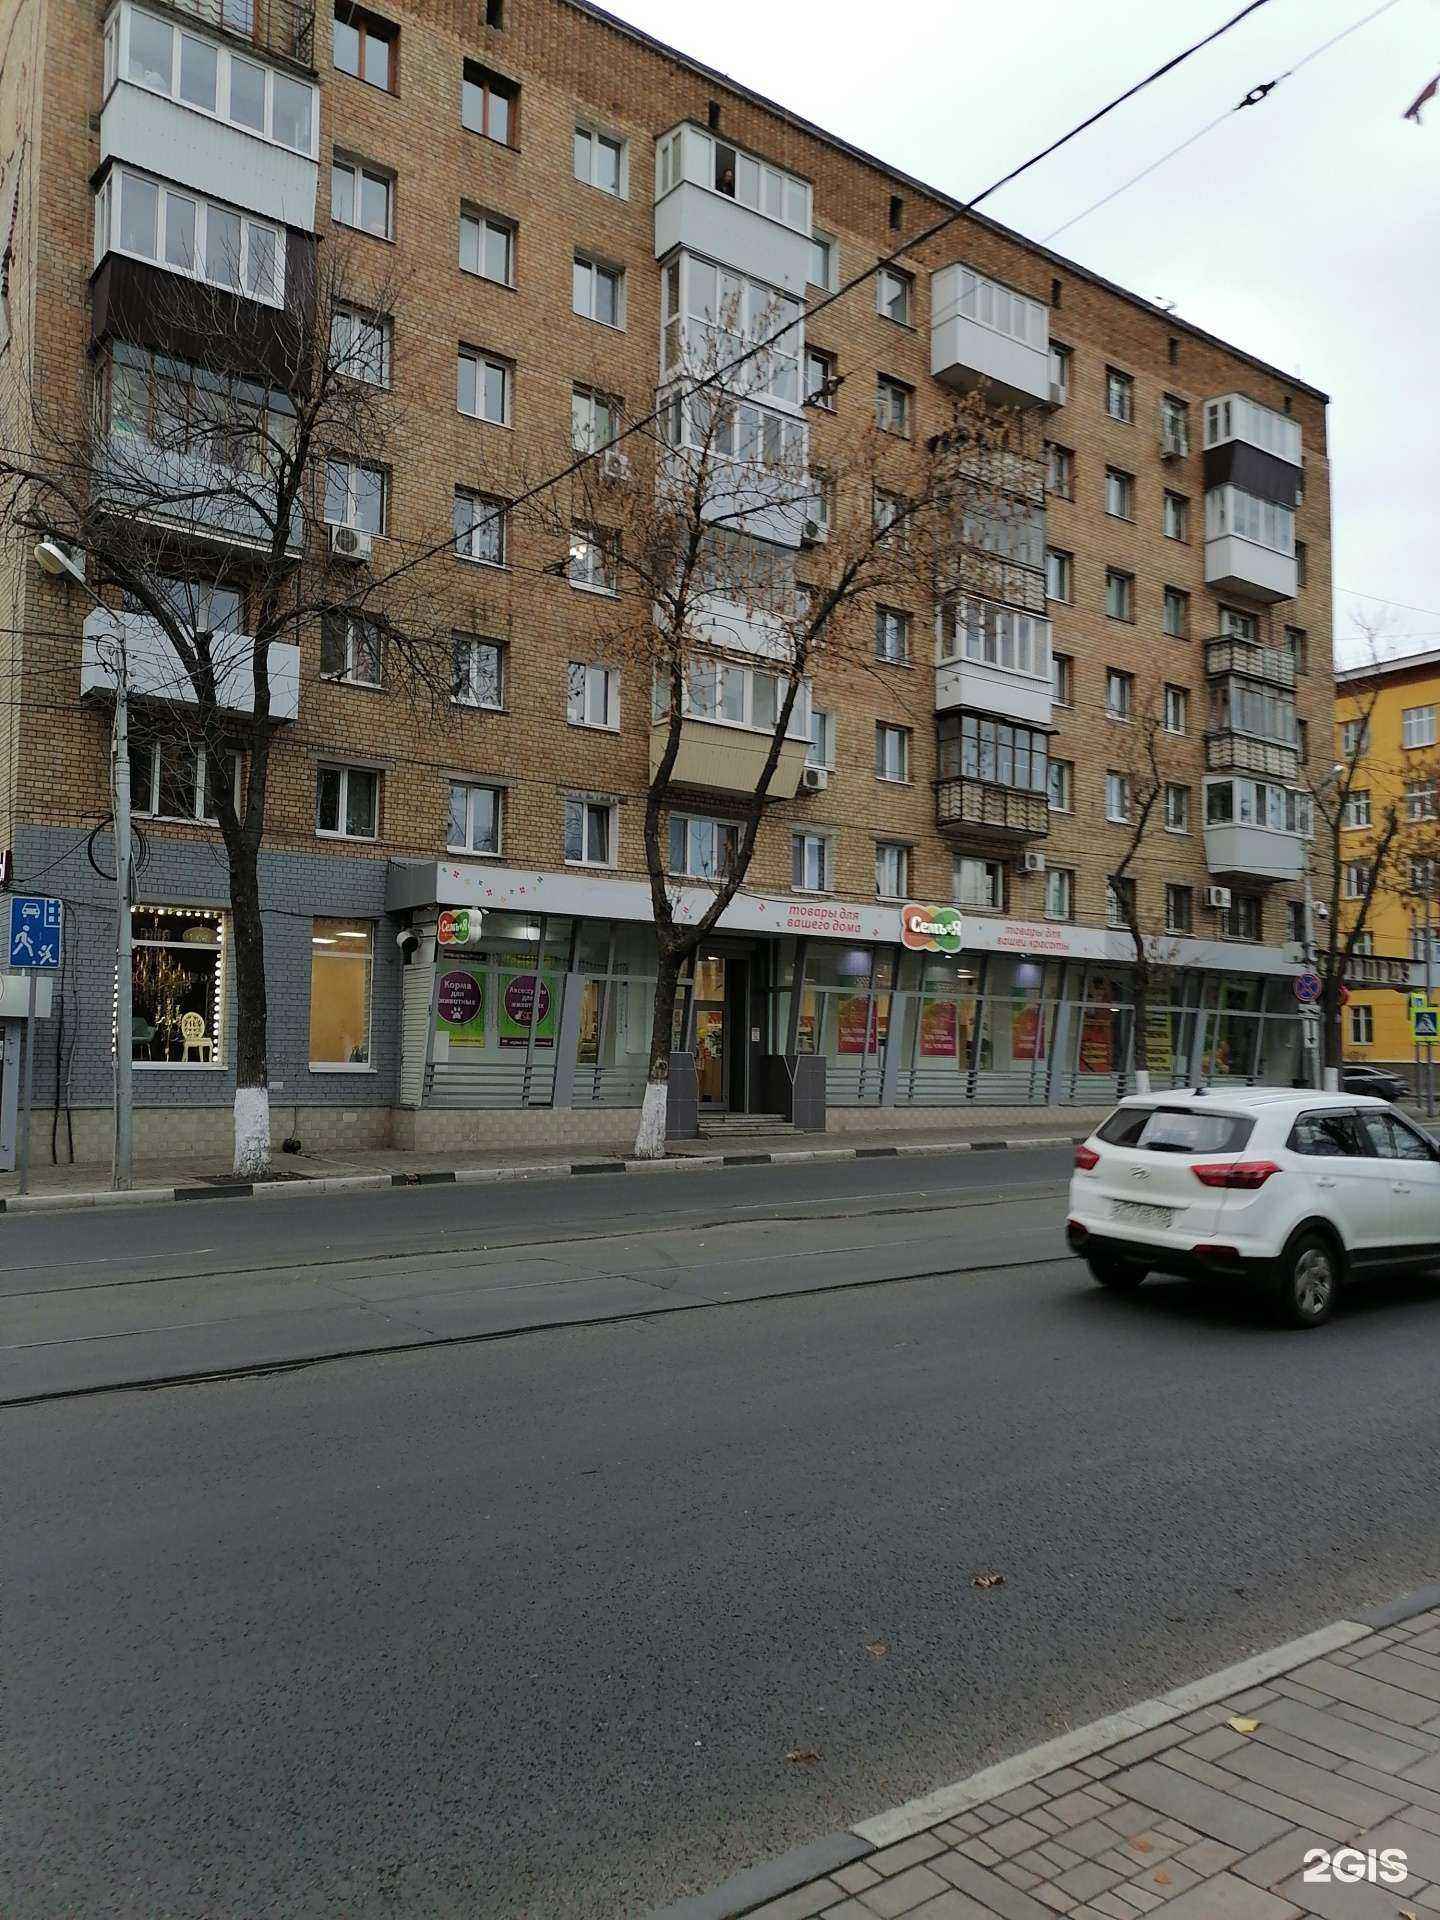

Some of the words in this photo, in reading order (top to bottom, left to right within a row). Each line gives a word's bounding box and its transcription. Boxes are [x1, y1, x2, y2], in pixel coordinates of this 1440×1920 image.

[788, 905, 838, 921] товары
[839, 907, 859, 920] для
[787, 918, 830, 930] вашего
[832, 919, 861, 933] дома
[444, 980, 472, 991] Корма
